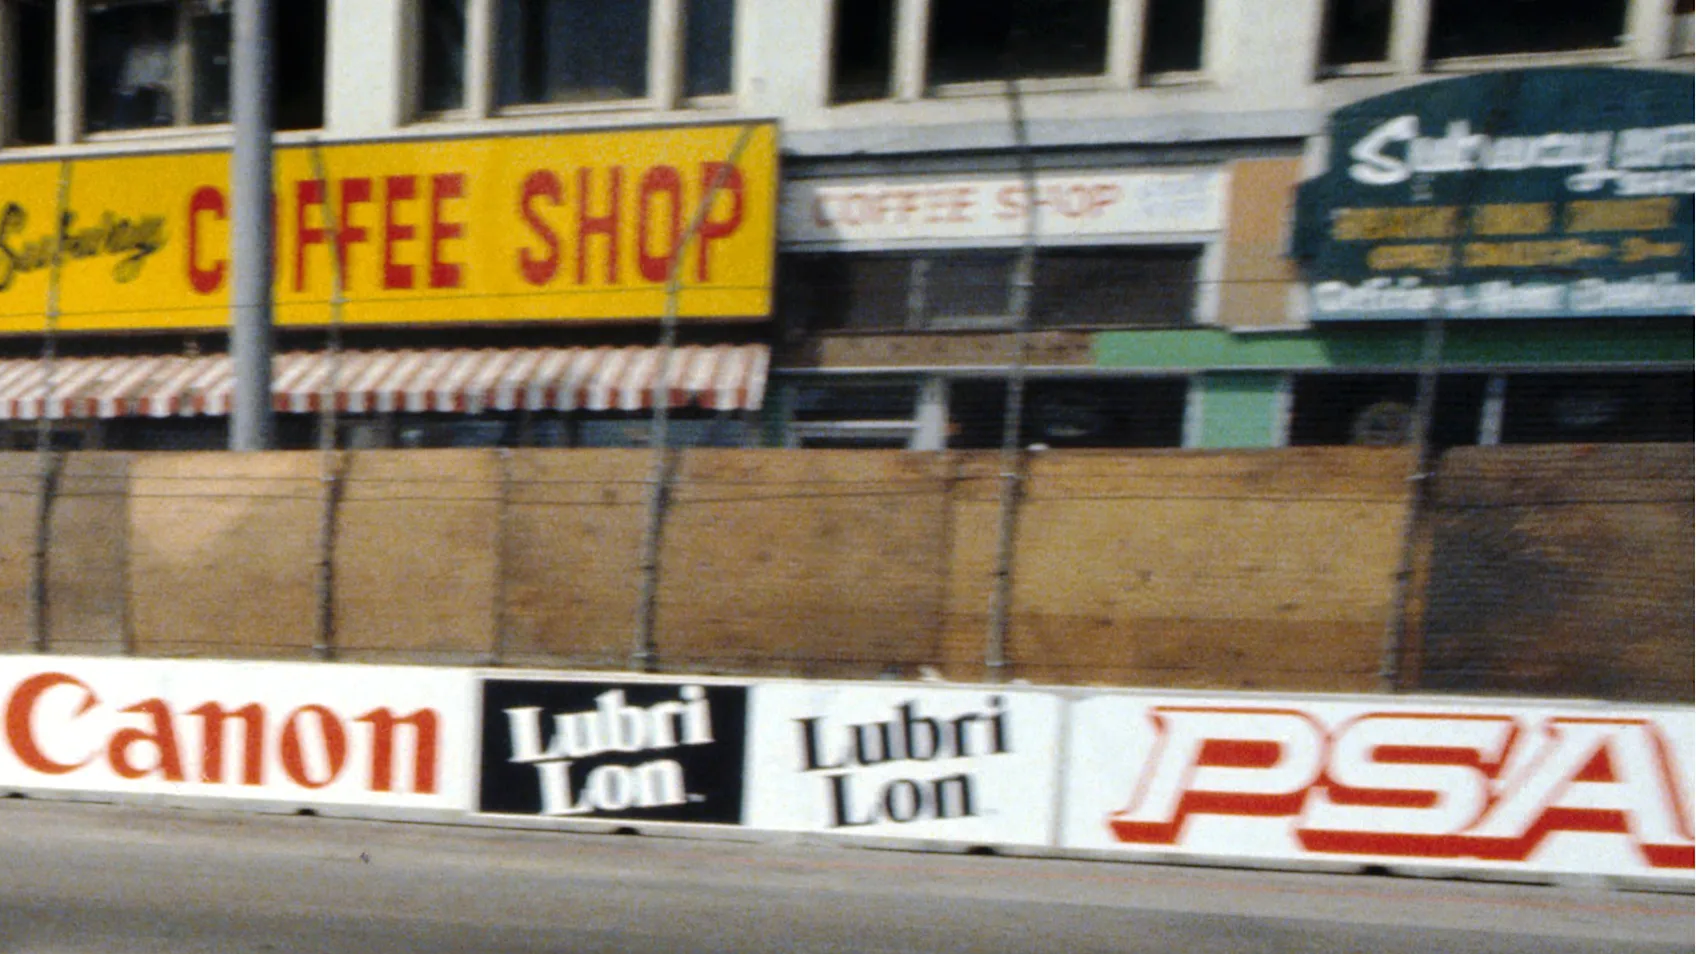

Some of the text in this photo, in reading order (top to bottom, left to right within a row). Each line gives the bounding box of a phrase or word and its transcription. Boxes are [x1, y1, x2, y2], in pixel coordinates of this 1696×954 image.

[188, 173, 468, 295] CFFEE
[520, 160, 746, 286] SHOP
[3, 671, 443, 795] Canon
[505, 684, 717, 762] Lubri
[789, 694, 1015, 771] Lubri
[534, 757, 688, 815] Lon
[823, 772, 981, 828] Lon
[1109, 704, 1694, 870] PSA
